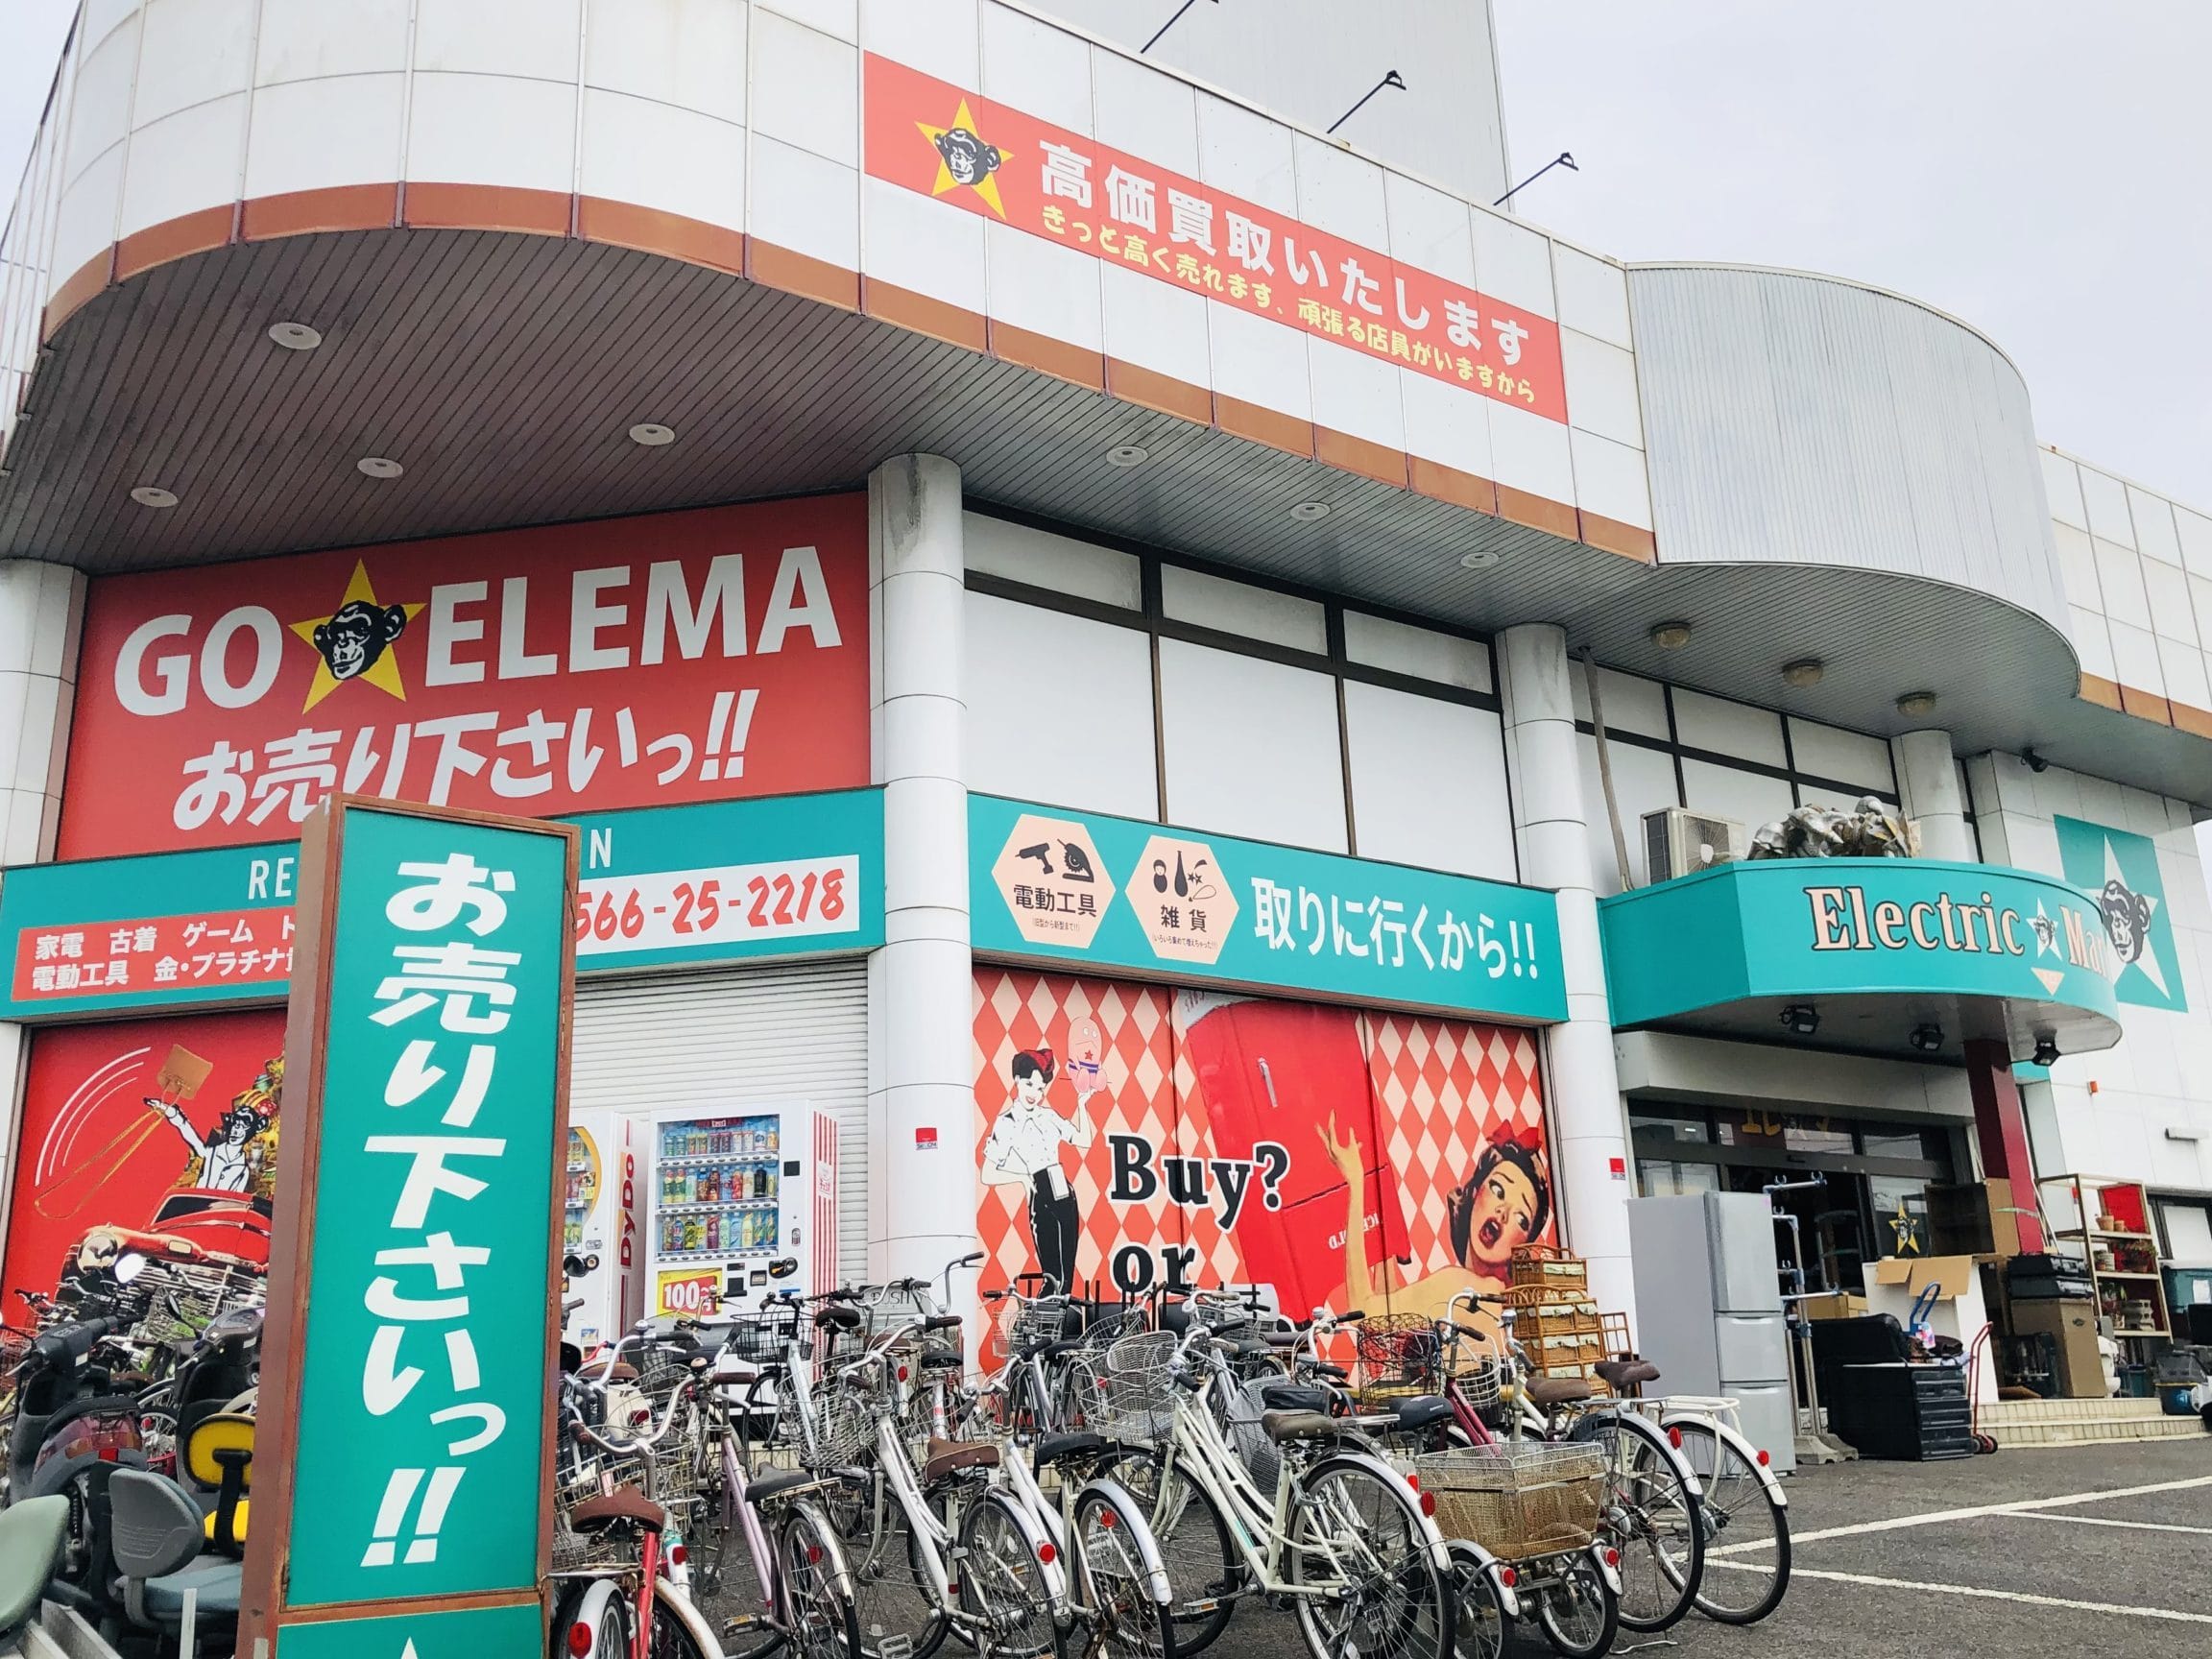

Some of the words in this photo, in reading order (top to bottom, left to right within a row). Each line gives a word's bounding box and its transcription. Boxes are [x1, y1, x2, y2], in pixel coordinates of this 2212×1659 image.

[1040, 139, 1529, 367] 高価買取いたします
[114, 605, 283, 716] GO
[424, 545, 843, 687] ELEMA
[1013, 883, 1097, 918] 電動工具
[1803, 886, 2025, 956] Electric
[35, 931, 84, 960] 家電
[109, 926, 157, 955] 古着
[182, 919, 253, 949] ゲーム
[32, 960, 130, 992] 電動工具
[1108, 1135, 1288, 1231] Buy?
[1113, 1245, 1195, 1293] or
